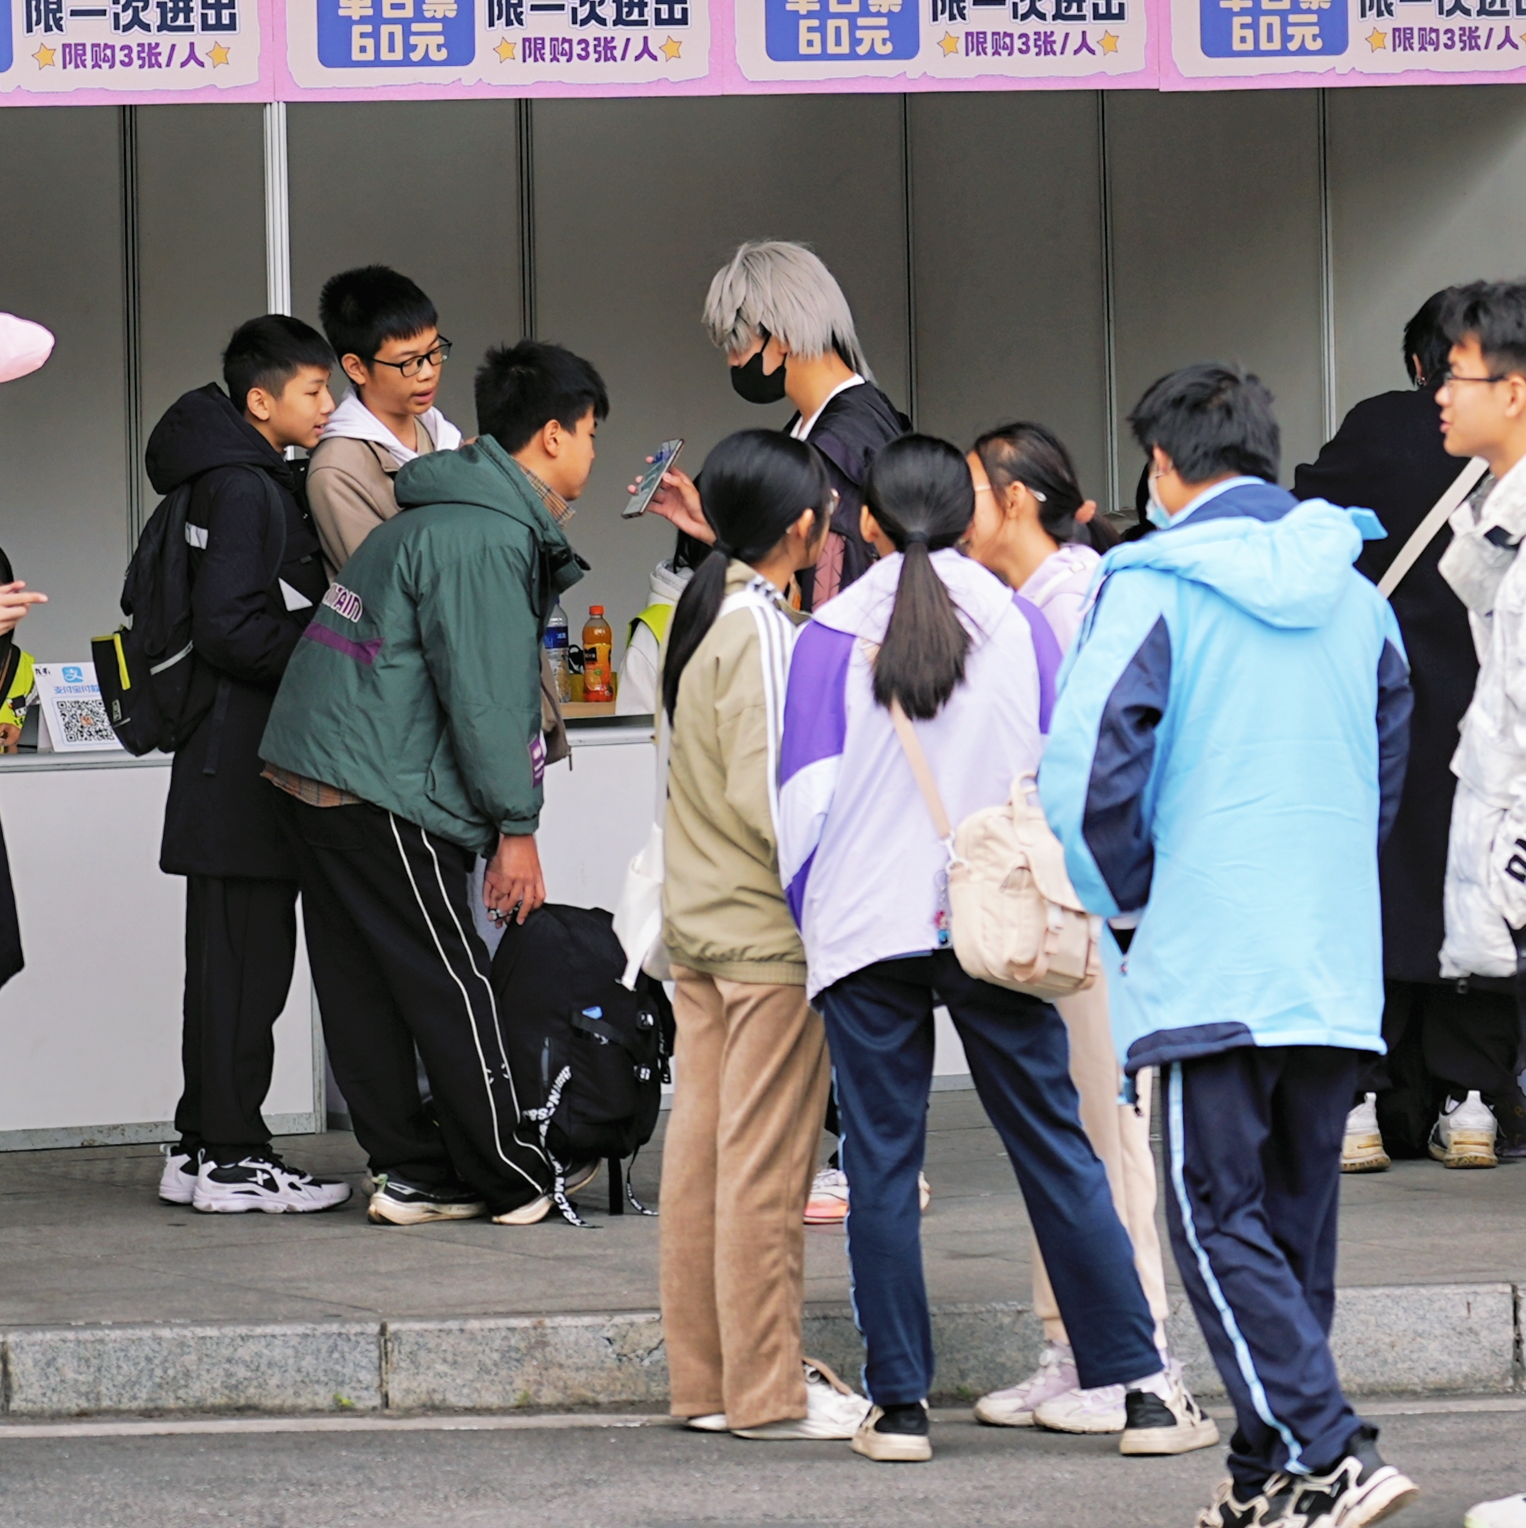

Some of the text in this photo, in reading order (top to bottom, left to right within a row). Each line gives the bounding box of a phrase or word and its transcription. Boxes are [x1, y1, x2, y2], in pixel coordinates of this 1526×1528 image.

[351, 22, 448, 62] 60元
[798, 17, 893, 56] 60元
[964, 30, 1097, 58] 限购3张/人
[1231, 14, 1323, 52] 60元
[1391, 26, 1520, 53] 限购3张/人
[61, 41, 205, 70] 限购3张/人
[521, 35, 659, 63] 限购3张/人
